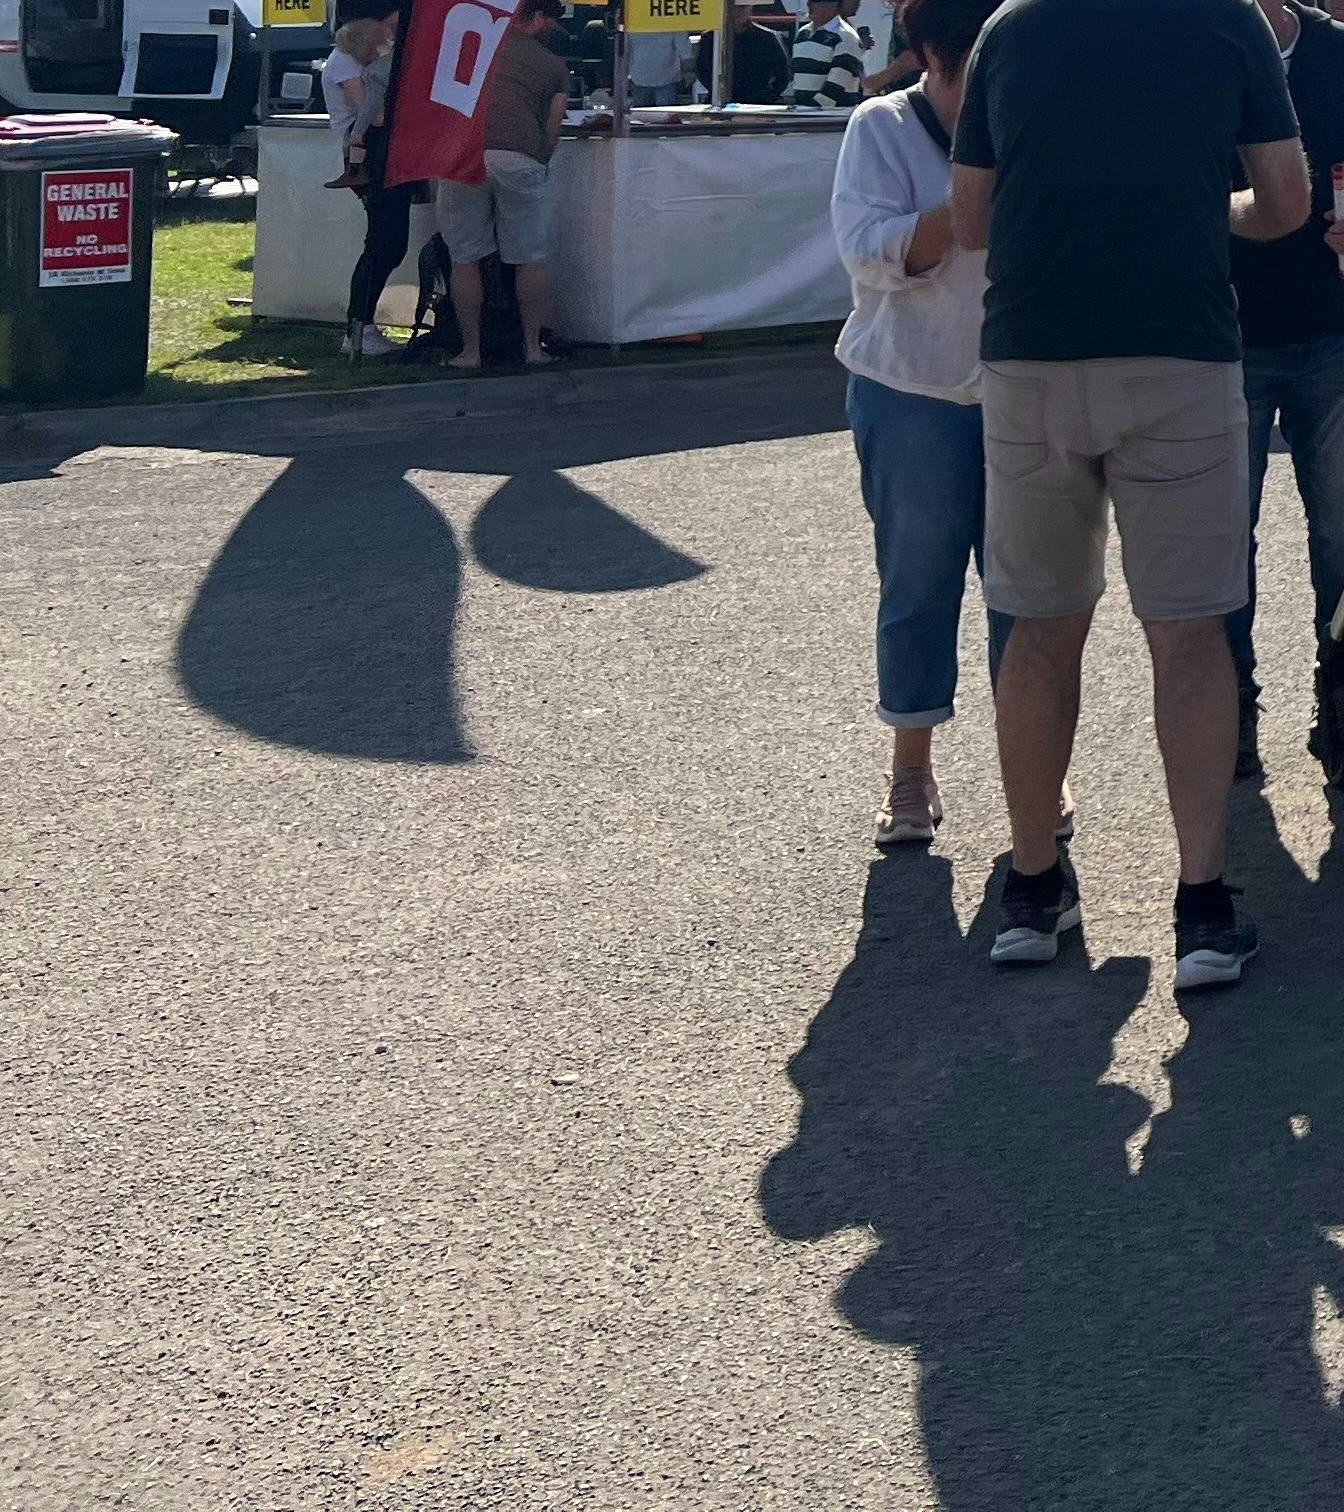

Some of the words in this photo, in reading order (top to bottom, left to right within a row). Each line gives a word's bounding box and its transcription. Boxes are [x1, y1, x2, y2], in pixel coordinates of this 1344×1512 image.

[47, 182, 129, 201] GENERAL
[57, 203, 119, 222] WASTE
[76, 234, 98, 245] NO
[43, 244, 128, 258] RECYCLING
